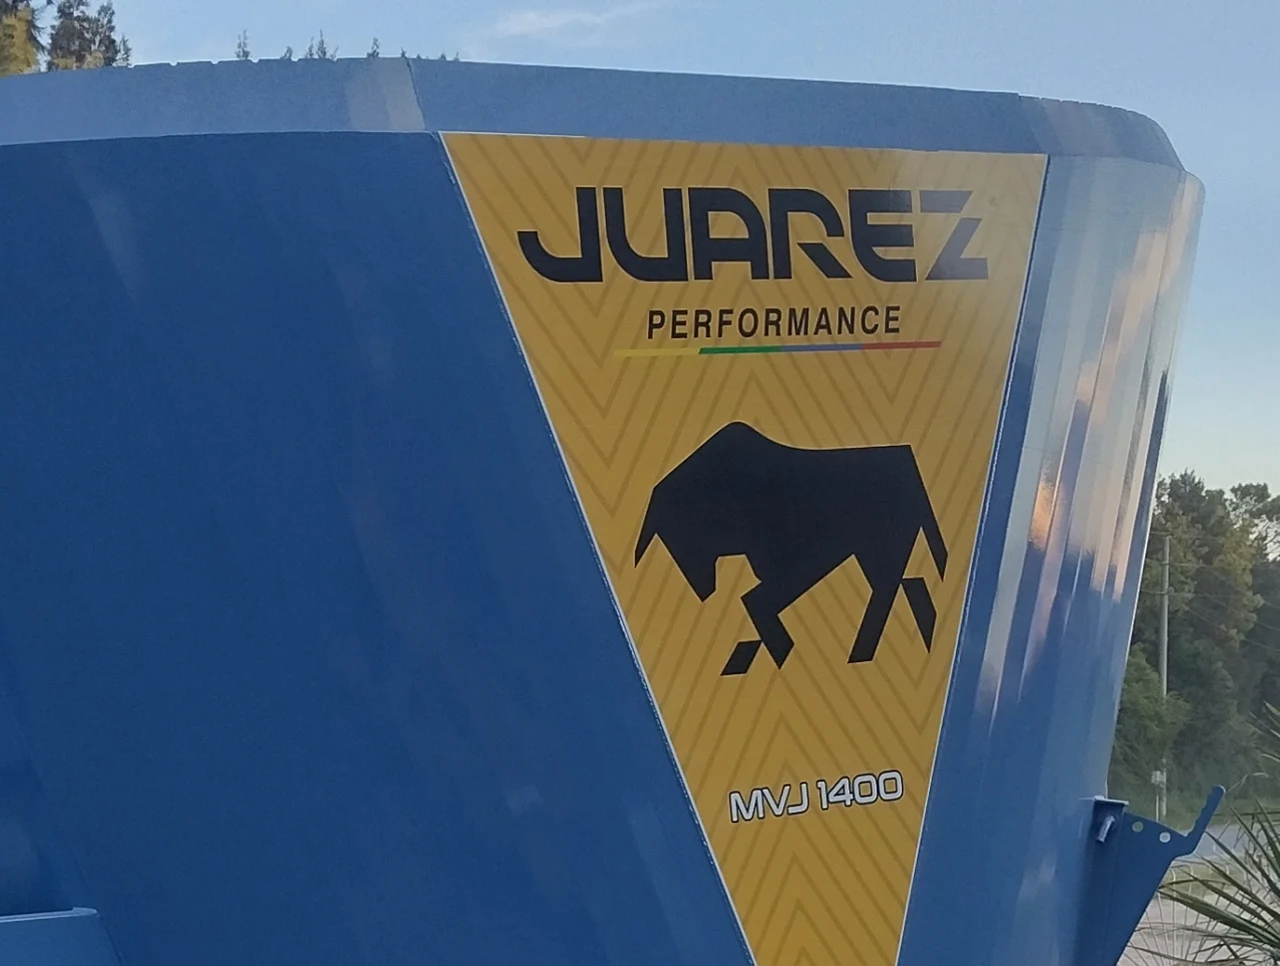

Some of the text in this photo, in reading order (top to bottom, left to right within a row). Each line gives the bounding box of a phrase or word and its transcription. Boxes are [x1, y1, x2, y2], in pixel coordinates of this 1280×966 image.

[517, 186, 989, 283] JUAREZ
[647, 305, 902, 340] PERFORMANCE
[729, 769, 905, 824] MVJ 1400
